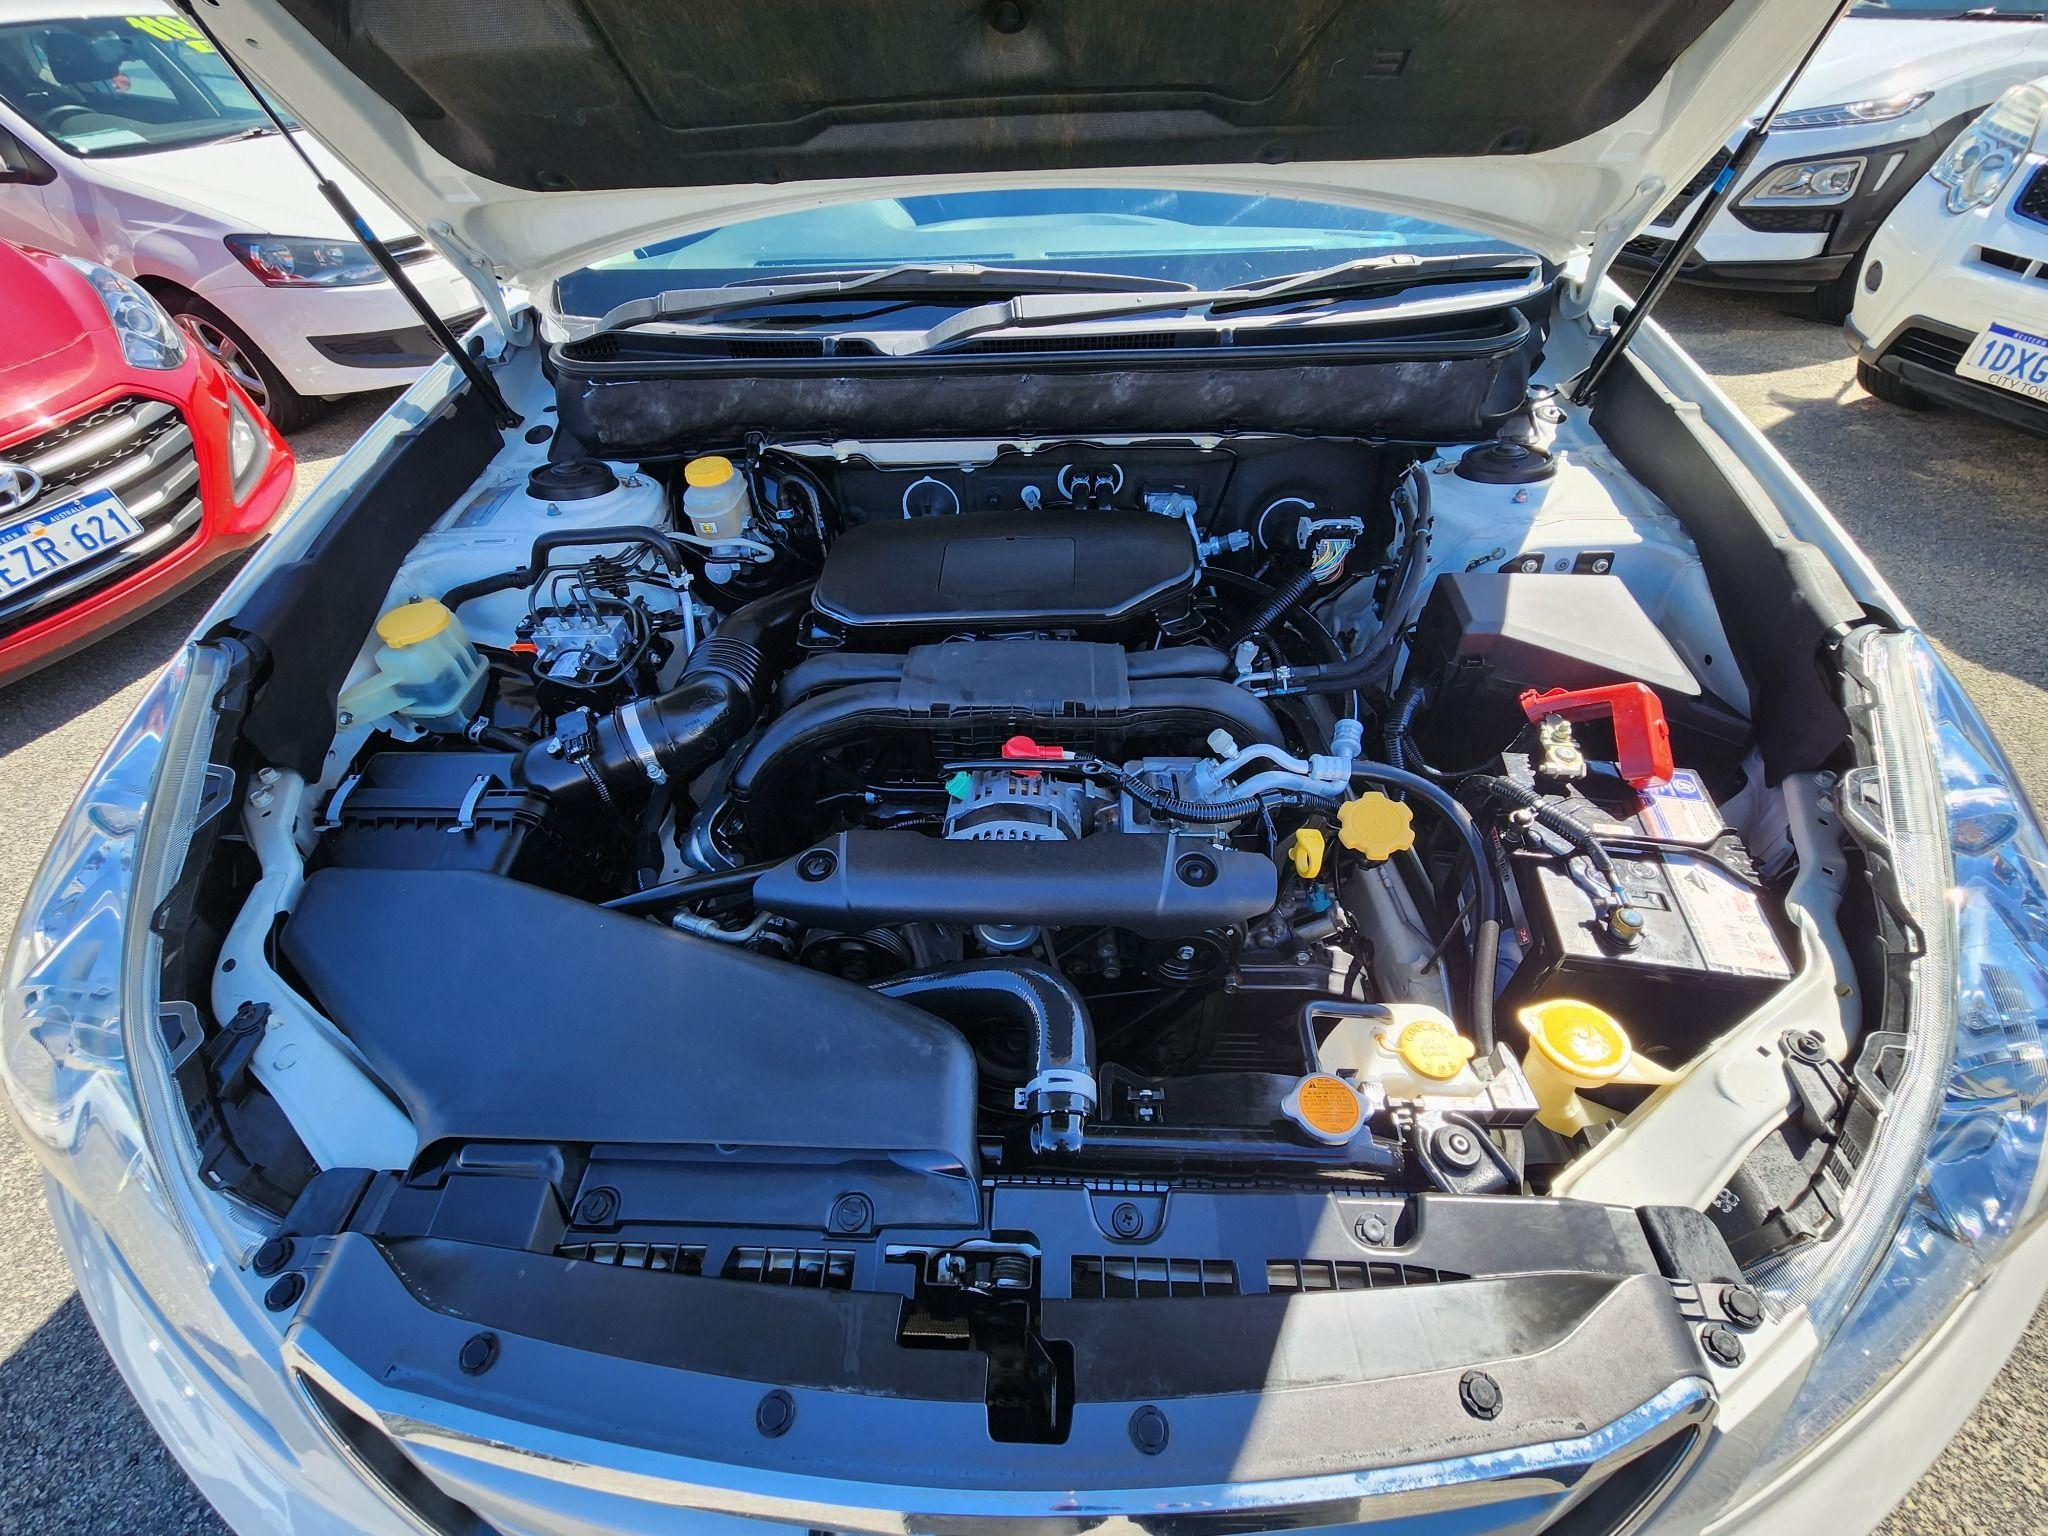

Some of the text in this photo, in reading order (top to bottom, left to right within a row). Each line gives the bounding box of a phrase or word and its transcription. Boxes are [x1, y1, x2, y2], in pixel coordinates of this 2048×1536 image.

[1978, 340, 2048, 384] 1DXG
[1988, 373, 2020, 389] CITY
[50, 504, 87, 523] AUSTRALIA
[0, 508, 130, 590] EZR 621
